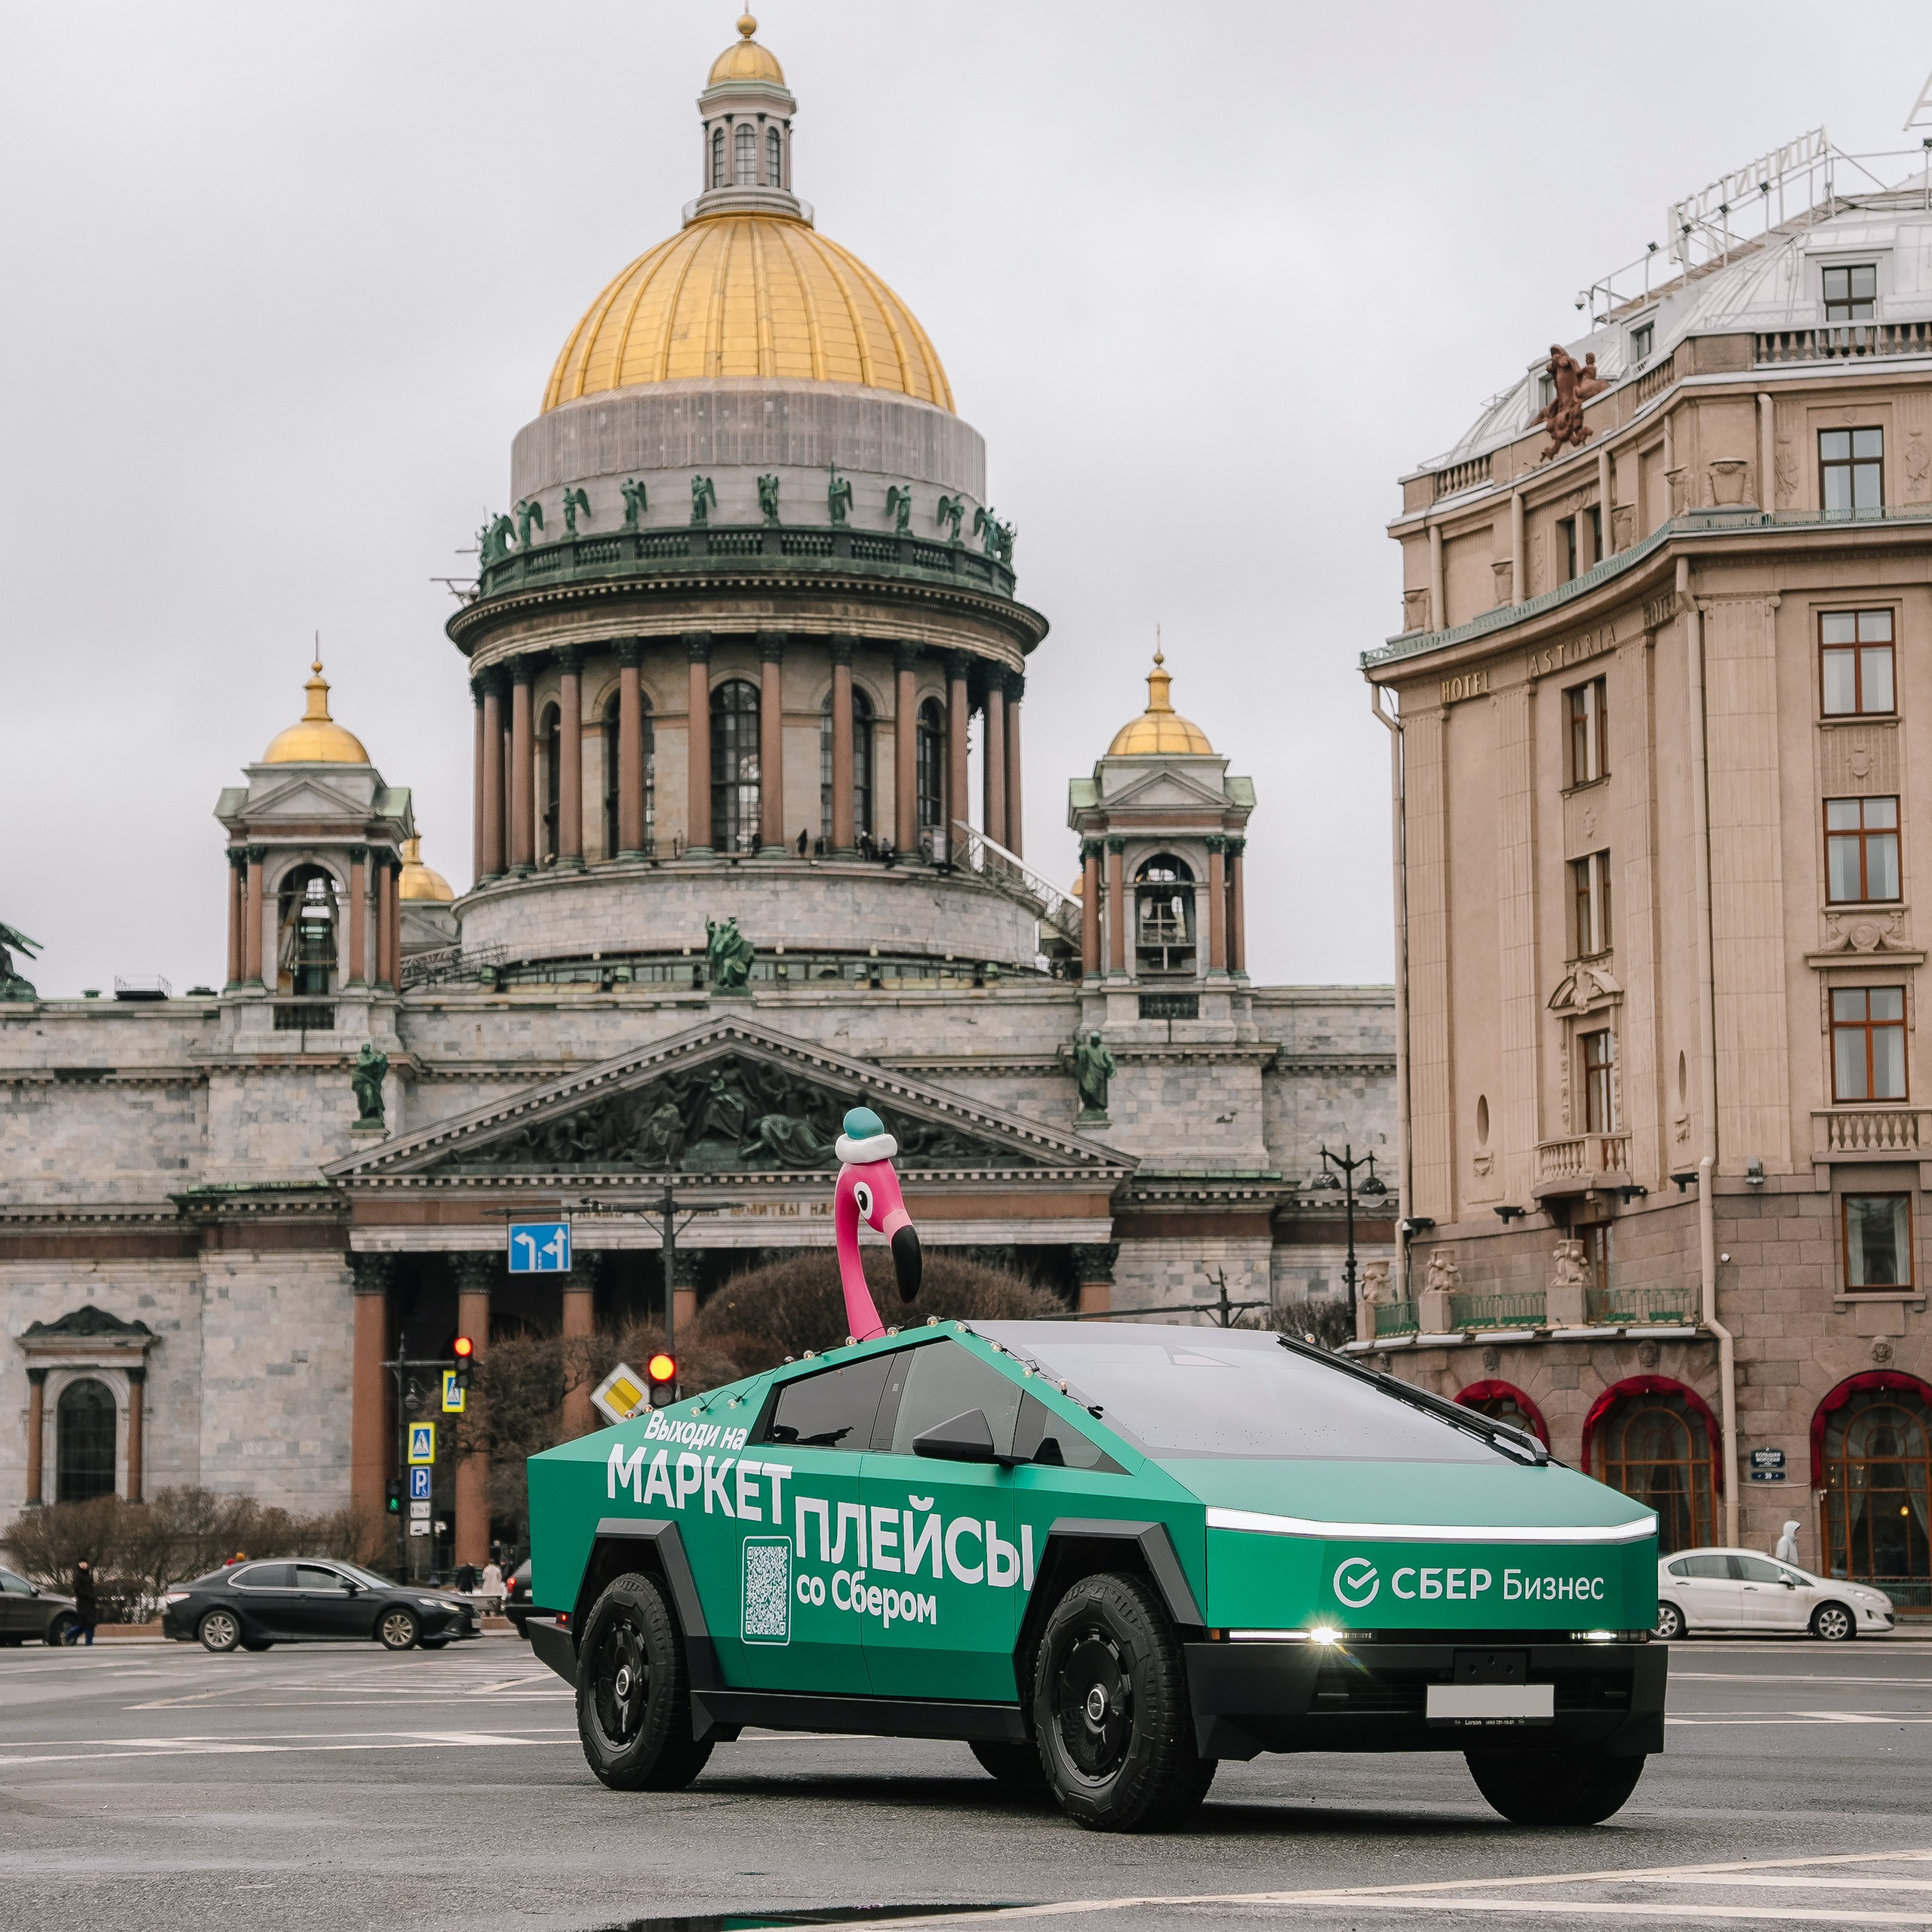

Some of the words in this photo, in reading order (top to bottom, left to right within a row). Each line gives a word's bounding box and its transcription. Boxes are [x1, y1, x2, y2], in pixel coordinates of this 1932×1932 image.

[1441, 670, 1490, 704] HOTEL
[1530, 624, 1617, 677] ASTORIA
[643, 1410, 721, 1451] Выходи
[718, 1426, 749, 1451] на
[607, 1443, 793, 1525] МАРКЕТ
[795, 1494, 1034, 1591] ПЛЕЙСЫ
[796, 1574, 826, 1607] со
[832, 1569, 937, 1629] Сбером
[1391, 1567, 1492, 1600] СБЕР
[1503, 1568, 1604, 1601] Бизнес
